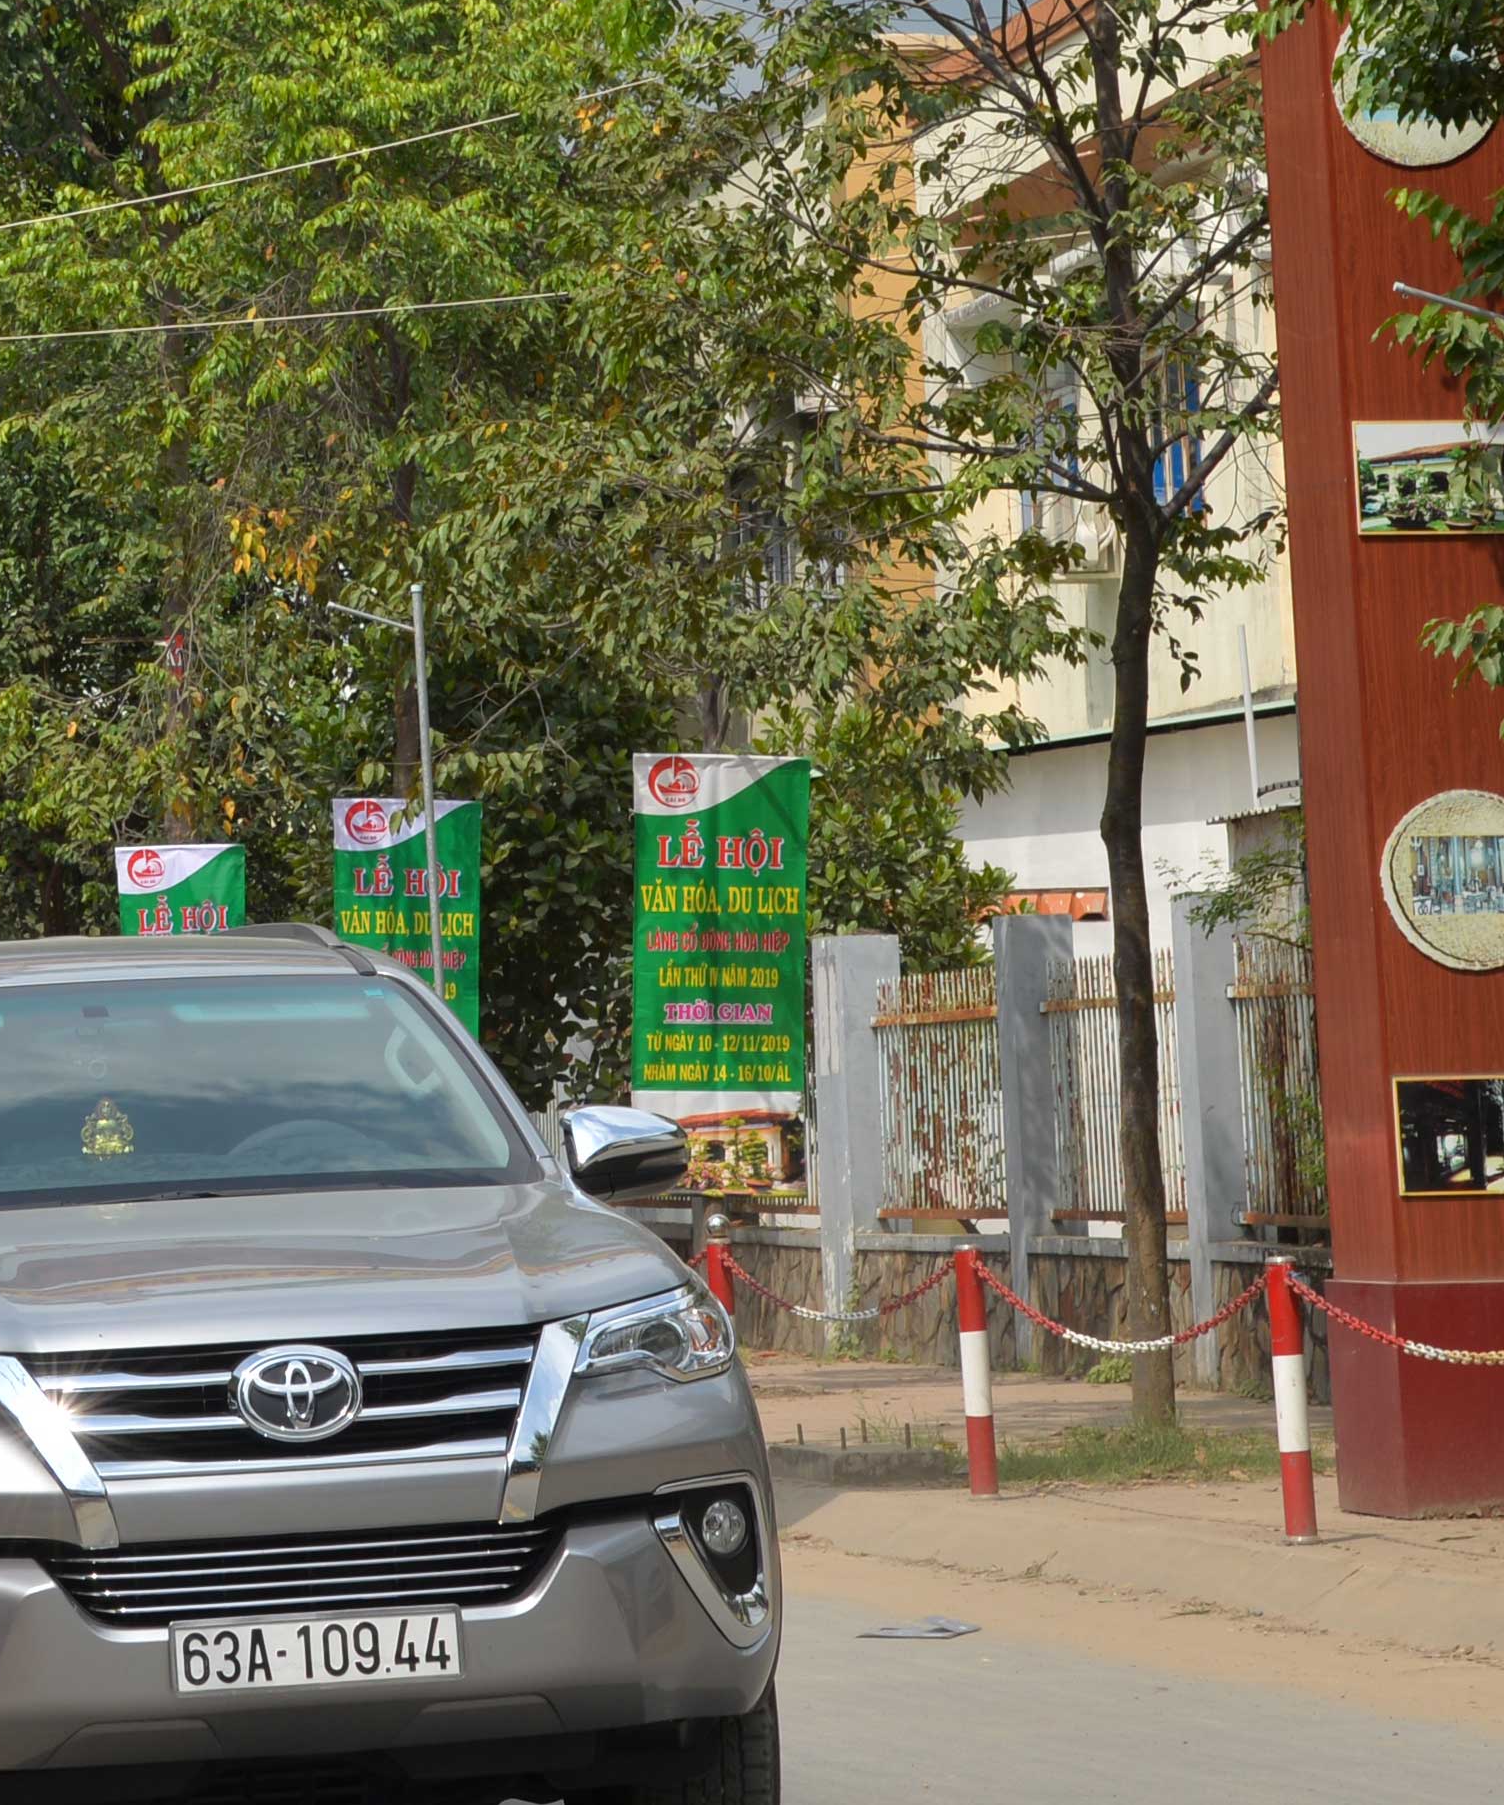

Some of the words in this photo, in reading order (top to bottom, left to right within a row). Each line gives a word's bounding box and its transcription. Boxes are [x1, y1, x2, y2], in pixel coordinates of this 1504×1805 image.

[657, 819, 704, 869] LỄ
[716, 828, 784, 876] HỘI
[354, 854, 393, 896] LỄ
[137, 896, 172, 934] LỄ
[181, 900, 228, 936] HỘI
[641, 878, 677, 913] VĂN
[682, 878, 721, 916] HÓA,
[728, 887, 752, 913] DU
[757, 887, 799, 919] LỊCH
[341, 905, 370, 936] VĂN
[375, 905, 410, 937] HÓA,
[440, 912, 474, 940] LỊCH
[647, 925, 677, 952] LÀNG
[659, 959, 680, 987] LẦN
[685, 963, 707, 987] THỨ
[709, 968, 718, 987] IV
[722, 964, 747, 987] NĂM
[751, 967, 779, 988] 2019
[665, 998, 714, 1021] THỜI
[718, 1003, 772, 1021] GIAN
[646, 1031, 663, 1052] TỪ
[665, 1032, 694, 1052] NGÀY
[699, 1035, 712, 1052] 10
[723, 1034, 790, 1053] 12/11/2019
[679, 1058, 709, 1082] NGÀY
[713, 1064, 727, 1081] 14
[738, 1059, 791, 1082] 16/10/ÂL
[181, 1612, 454, 1689] 63A-109.44
